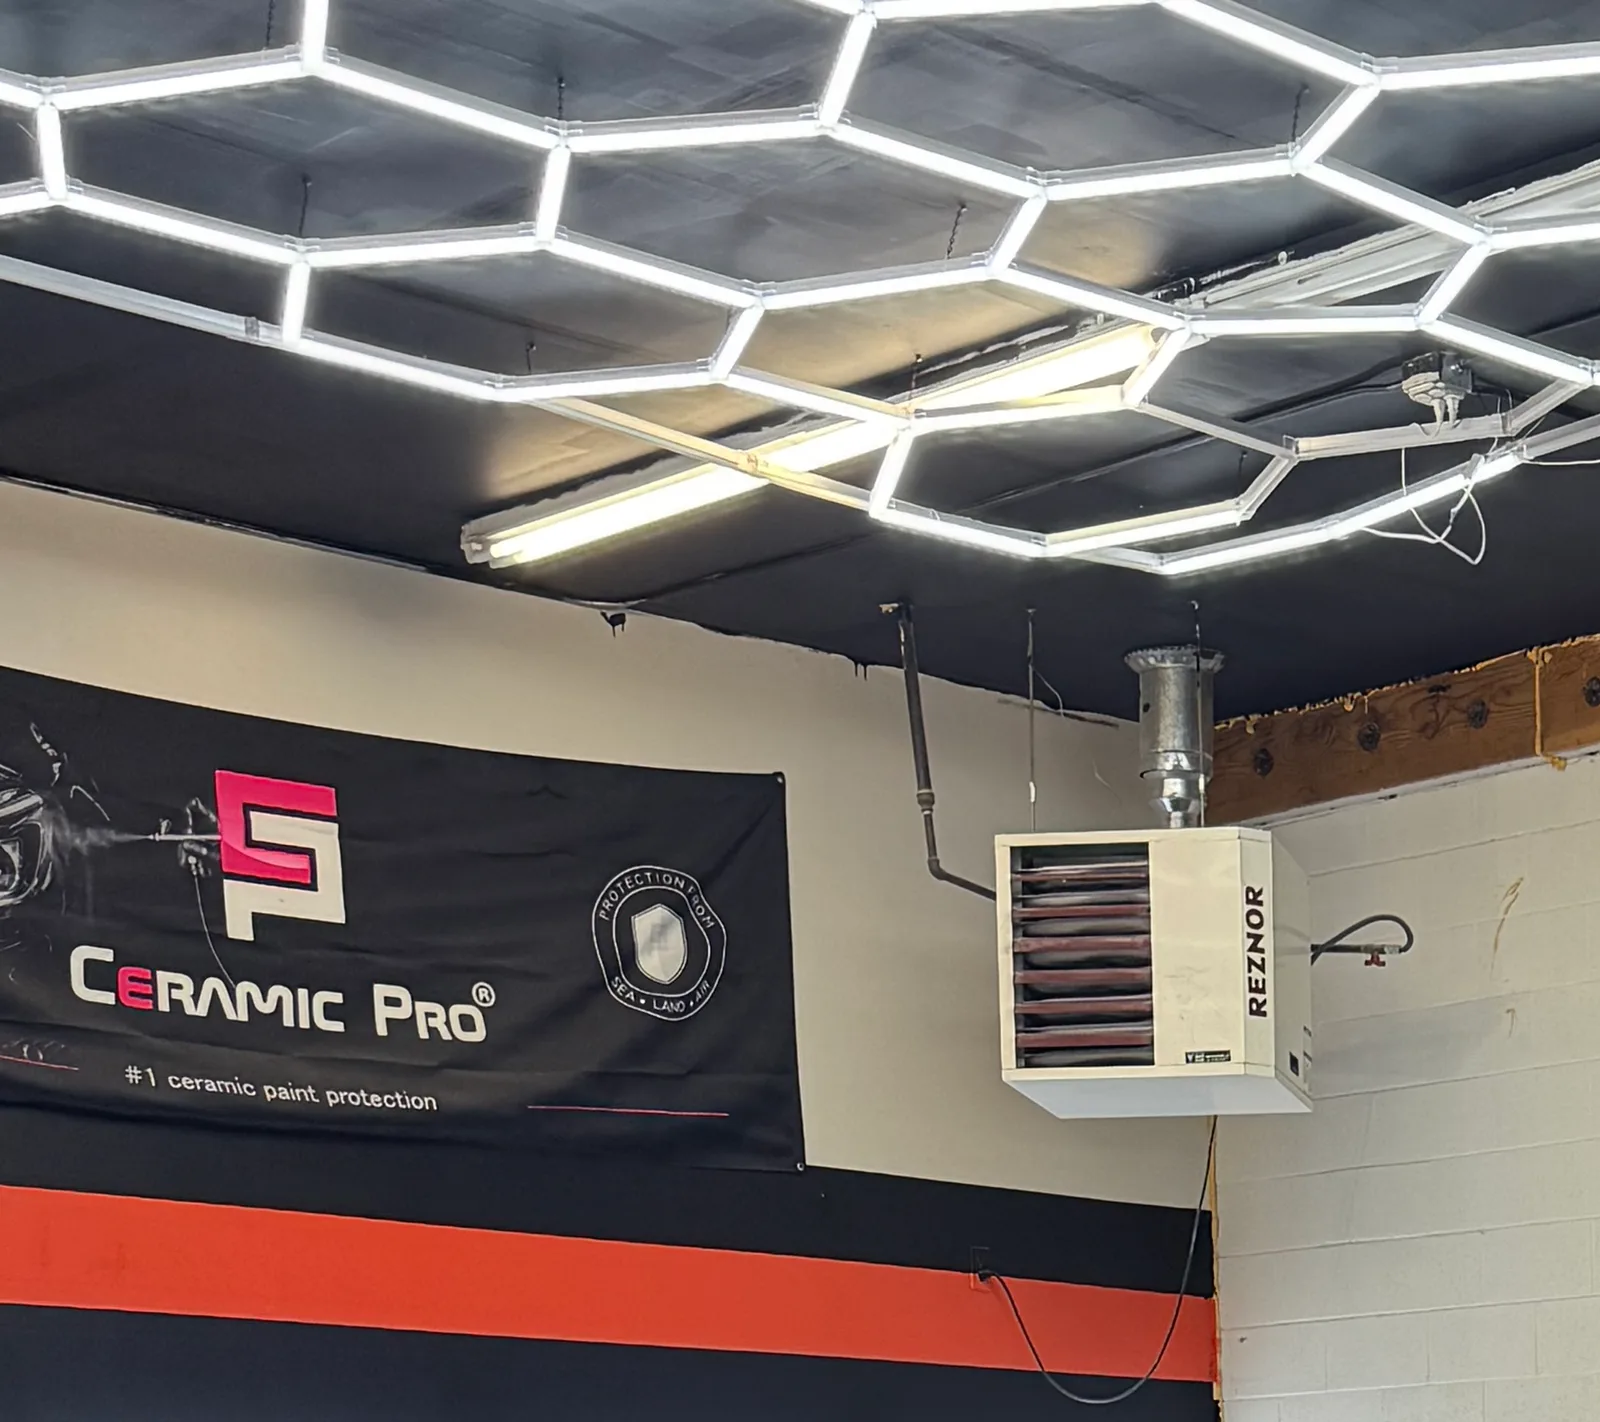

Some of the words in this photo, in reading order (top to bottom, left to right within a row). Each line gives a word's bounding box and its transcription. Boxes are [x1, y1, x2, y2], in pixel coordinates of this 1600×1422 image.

[598, 872, 685, 921] PROTECTION
[686, 886, 716, 928] FROM
[1245, 886, 1267, 1018] REZNOR
[70, 945, 345, 1032] CERAMIC
[611, 976, 635, 1002] SEA
[653, 999, 686, 1013] LAND
[125, 1065, 157, 1088] #1
[168, 1072, 256, 1096] ceramic
[264, 1082, 319, 1104] paint
[326, 1089, 438, 1112] protection
